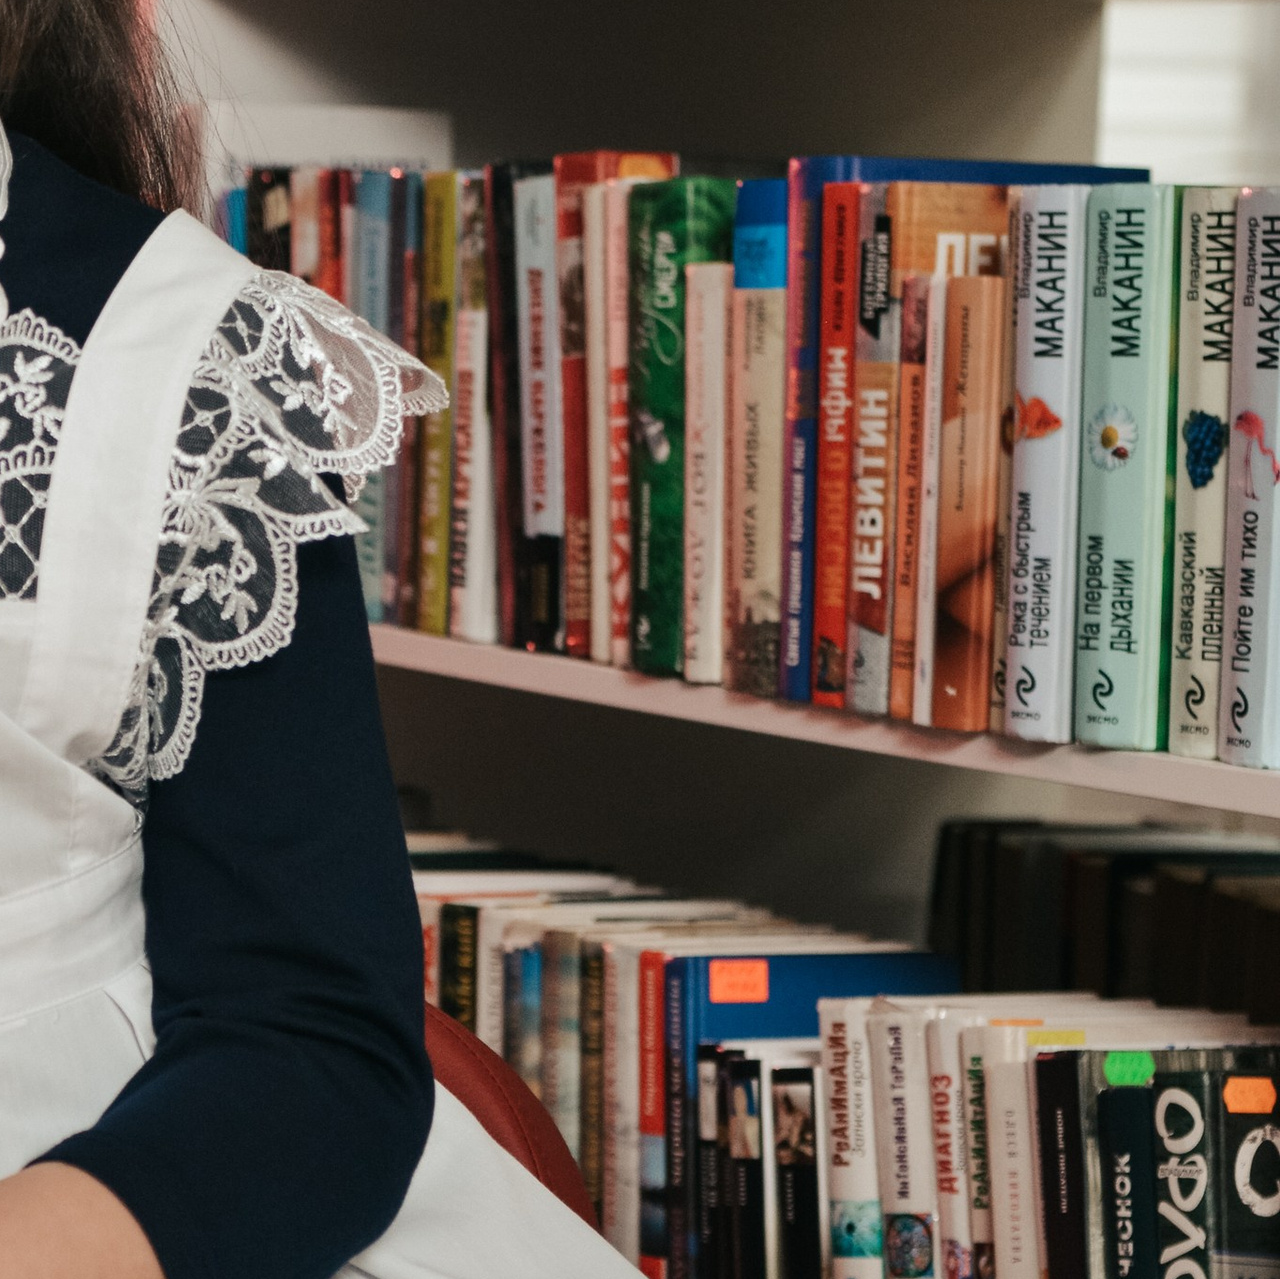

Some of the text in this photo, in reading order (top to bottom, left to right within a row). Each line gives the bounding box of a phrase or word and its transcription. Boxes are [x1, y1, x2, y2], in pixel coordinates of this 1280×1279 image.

[1020, 210, 1034, 299] Владимир
[1033, 211, 1067, 358] МАКАНИН
[1094, 209, 1112, 297] Владимир
[1111, 208, 1145, 357] МАКАНИН
[1188, 212, 1203, 301] Владимир
[1203, 211, 1236, 362] МАКАНИН
[1243, 217, 1260, 307] Владимир
[1256, 215, 1280, 370] МАКАНИН
[743, 402, 760, 579] КНИГА ЖИВЫХ
[854, 389, 888, 601] ЛЕВИТИН
[1012, 492, 1037, 579] быстрым
[1009, 594, 1028, 648] Река
[1029, 557, 1051, 650] течением
[1079, 535, 1104, 651] На первом
[1110, 559, 1137, 654] дыхании
[1176, 531, 1197, 660] Кавказский
[1200, 566, 1225, 662] пленный
[1231, 510, 1259, 673] Пойте им тихо
[852, 1040, 866, 1158] Записки врача
[1116, 1152, 1134, 1276] ЧЕСНОК
